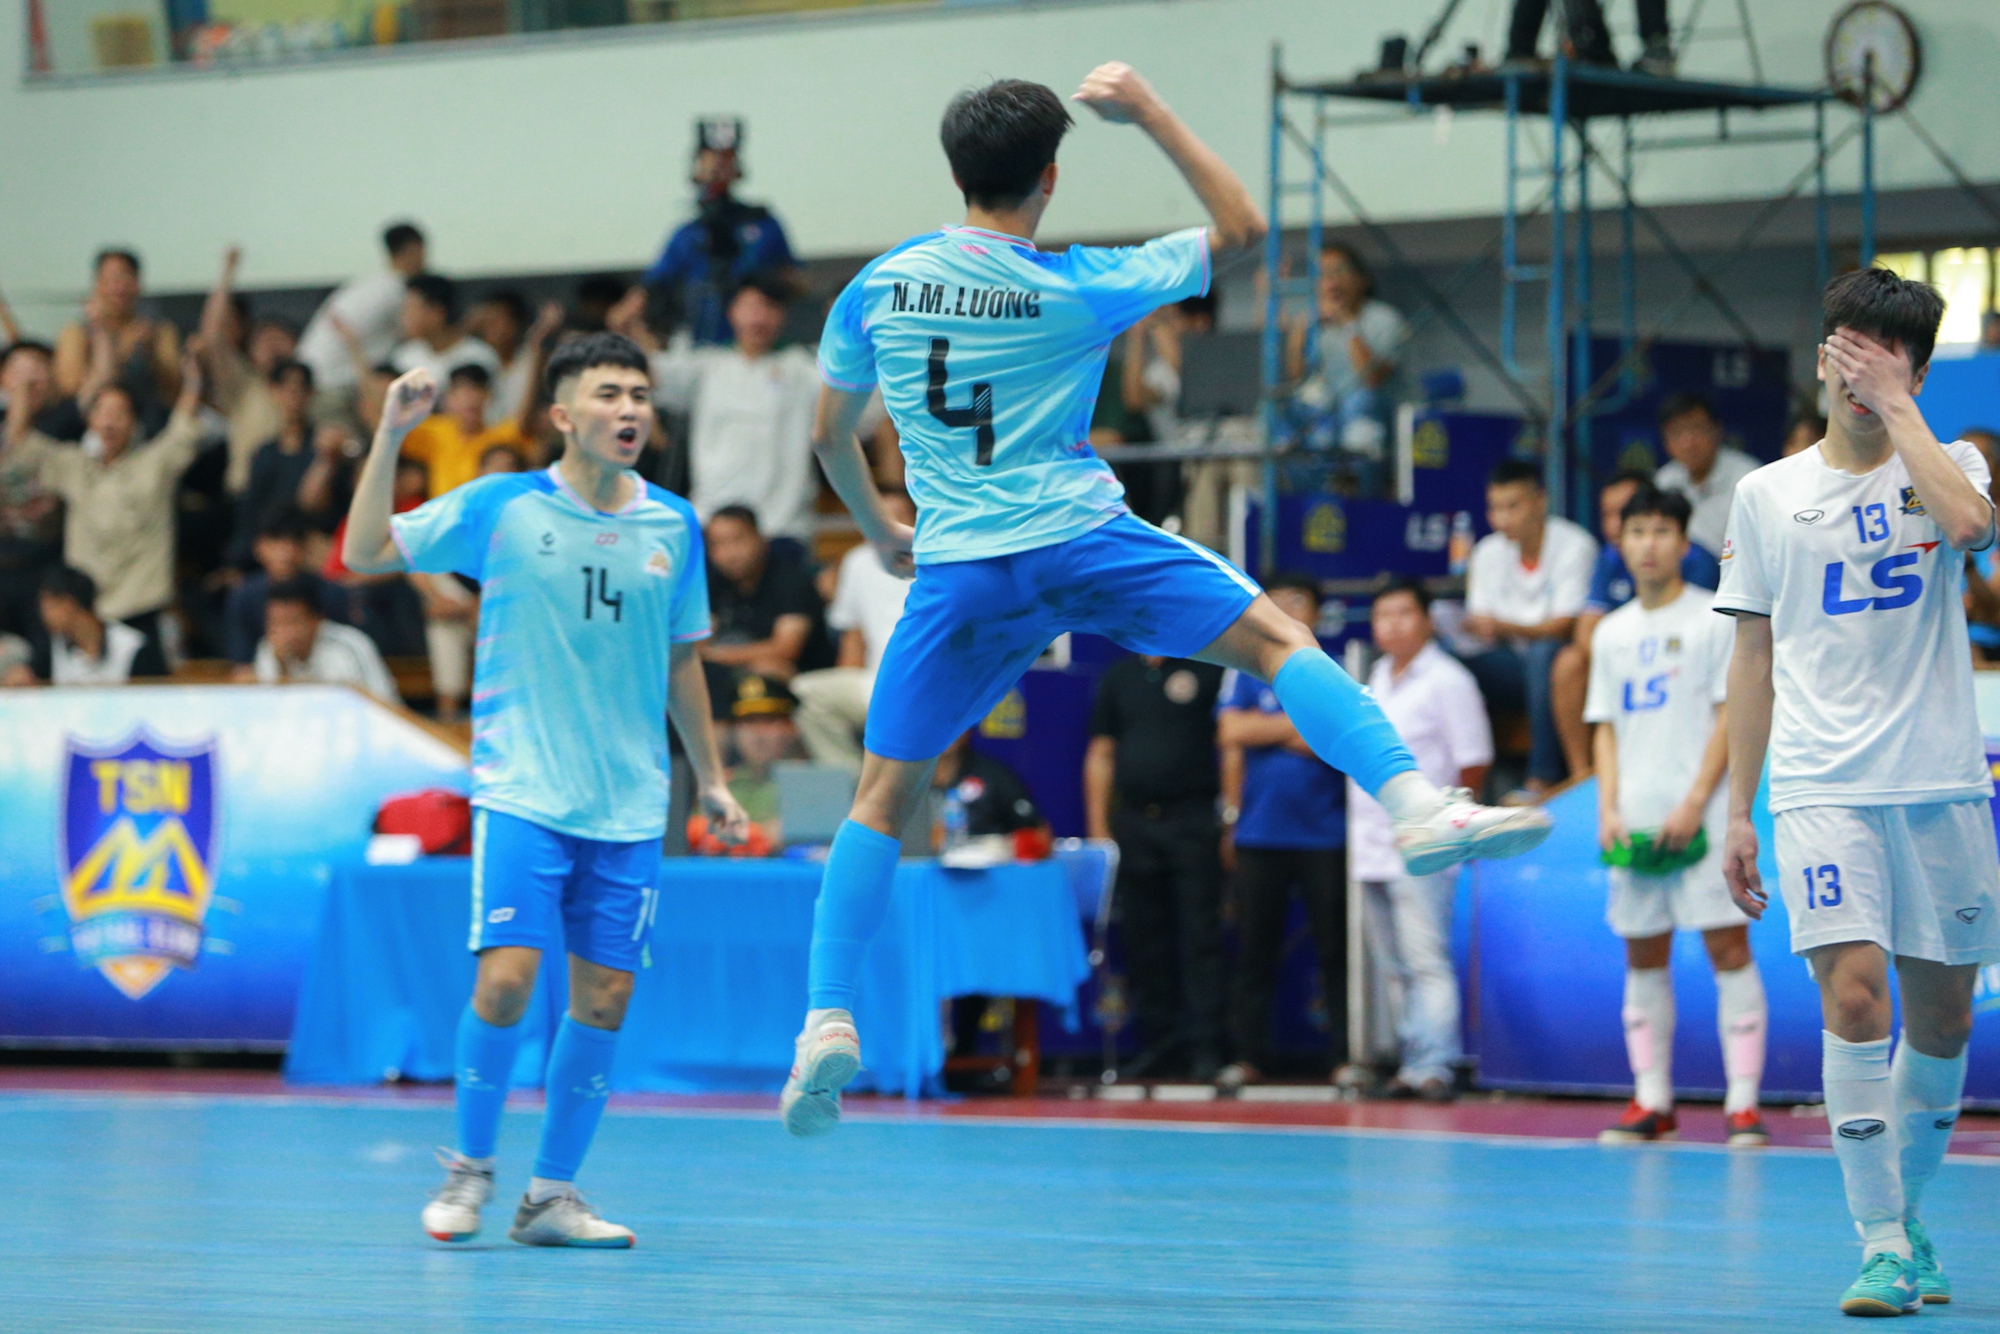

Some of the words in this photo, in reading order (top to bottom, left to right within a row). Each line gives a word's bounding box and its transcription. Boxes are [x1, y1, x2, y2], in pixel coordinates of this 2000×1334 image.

[891, 281, 1041, 319] N.M.LƯƠNG
[927, 336, 995, 466] 4
[1852, 503, 1890, 543] 13
[582, 566, 623, 622] 14
[1823, 551, 1923, 616] LS
[1623, 675, 1667, 712] LS
[91, 759, 191, 813] TSN
[1803, 864, 1842, 910] 13
